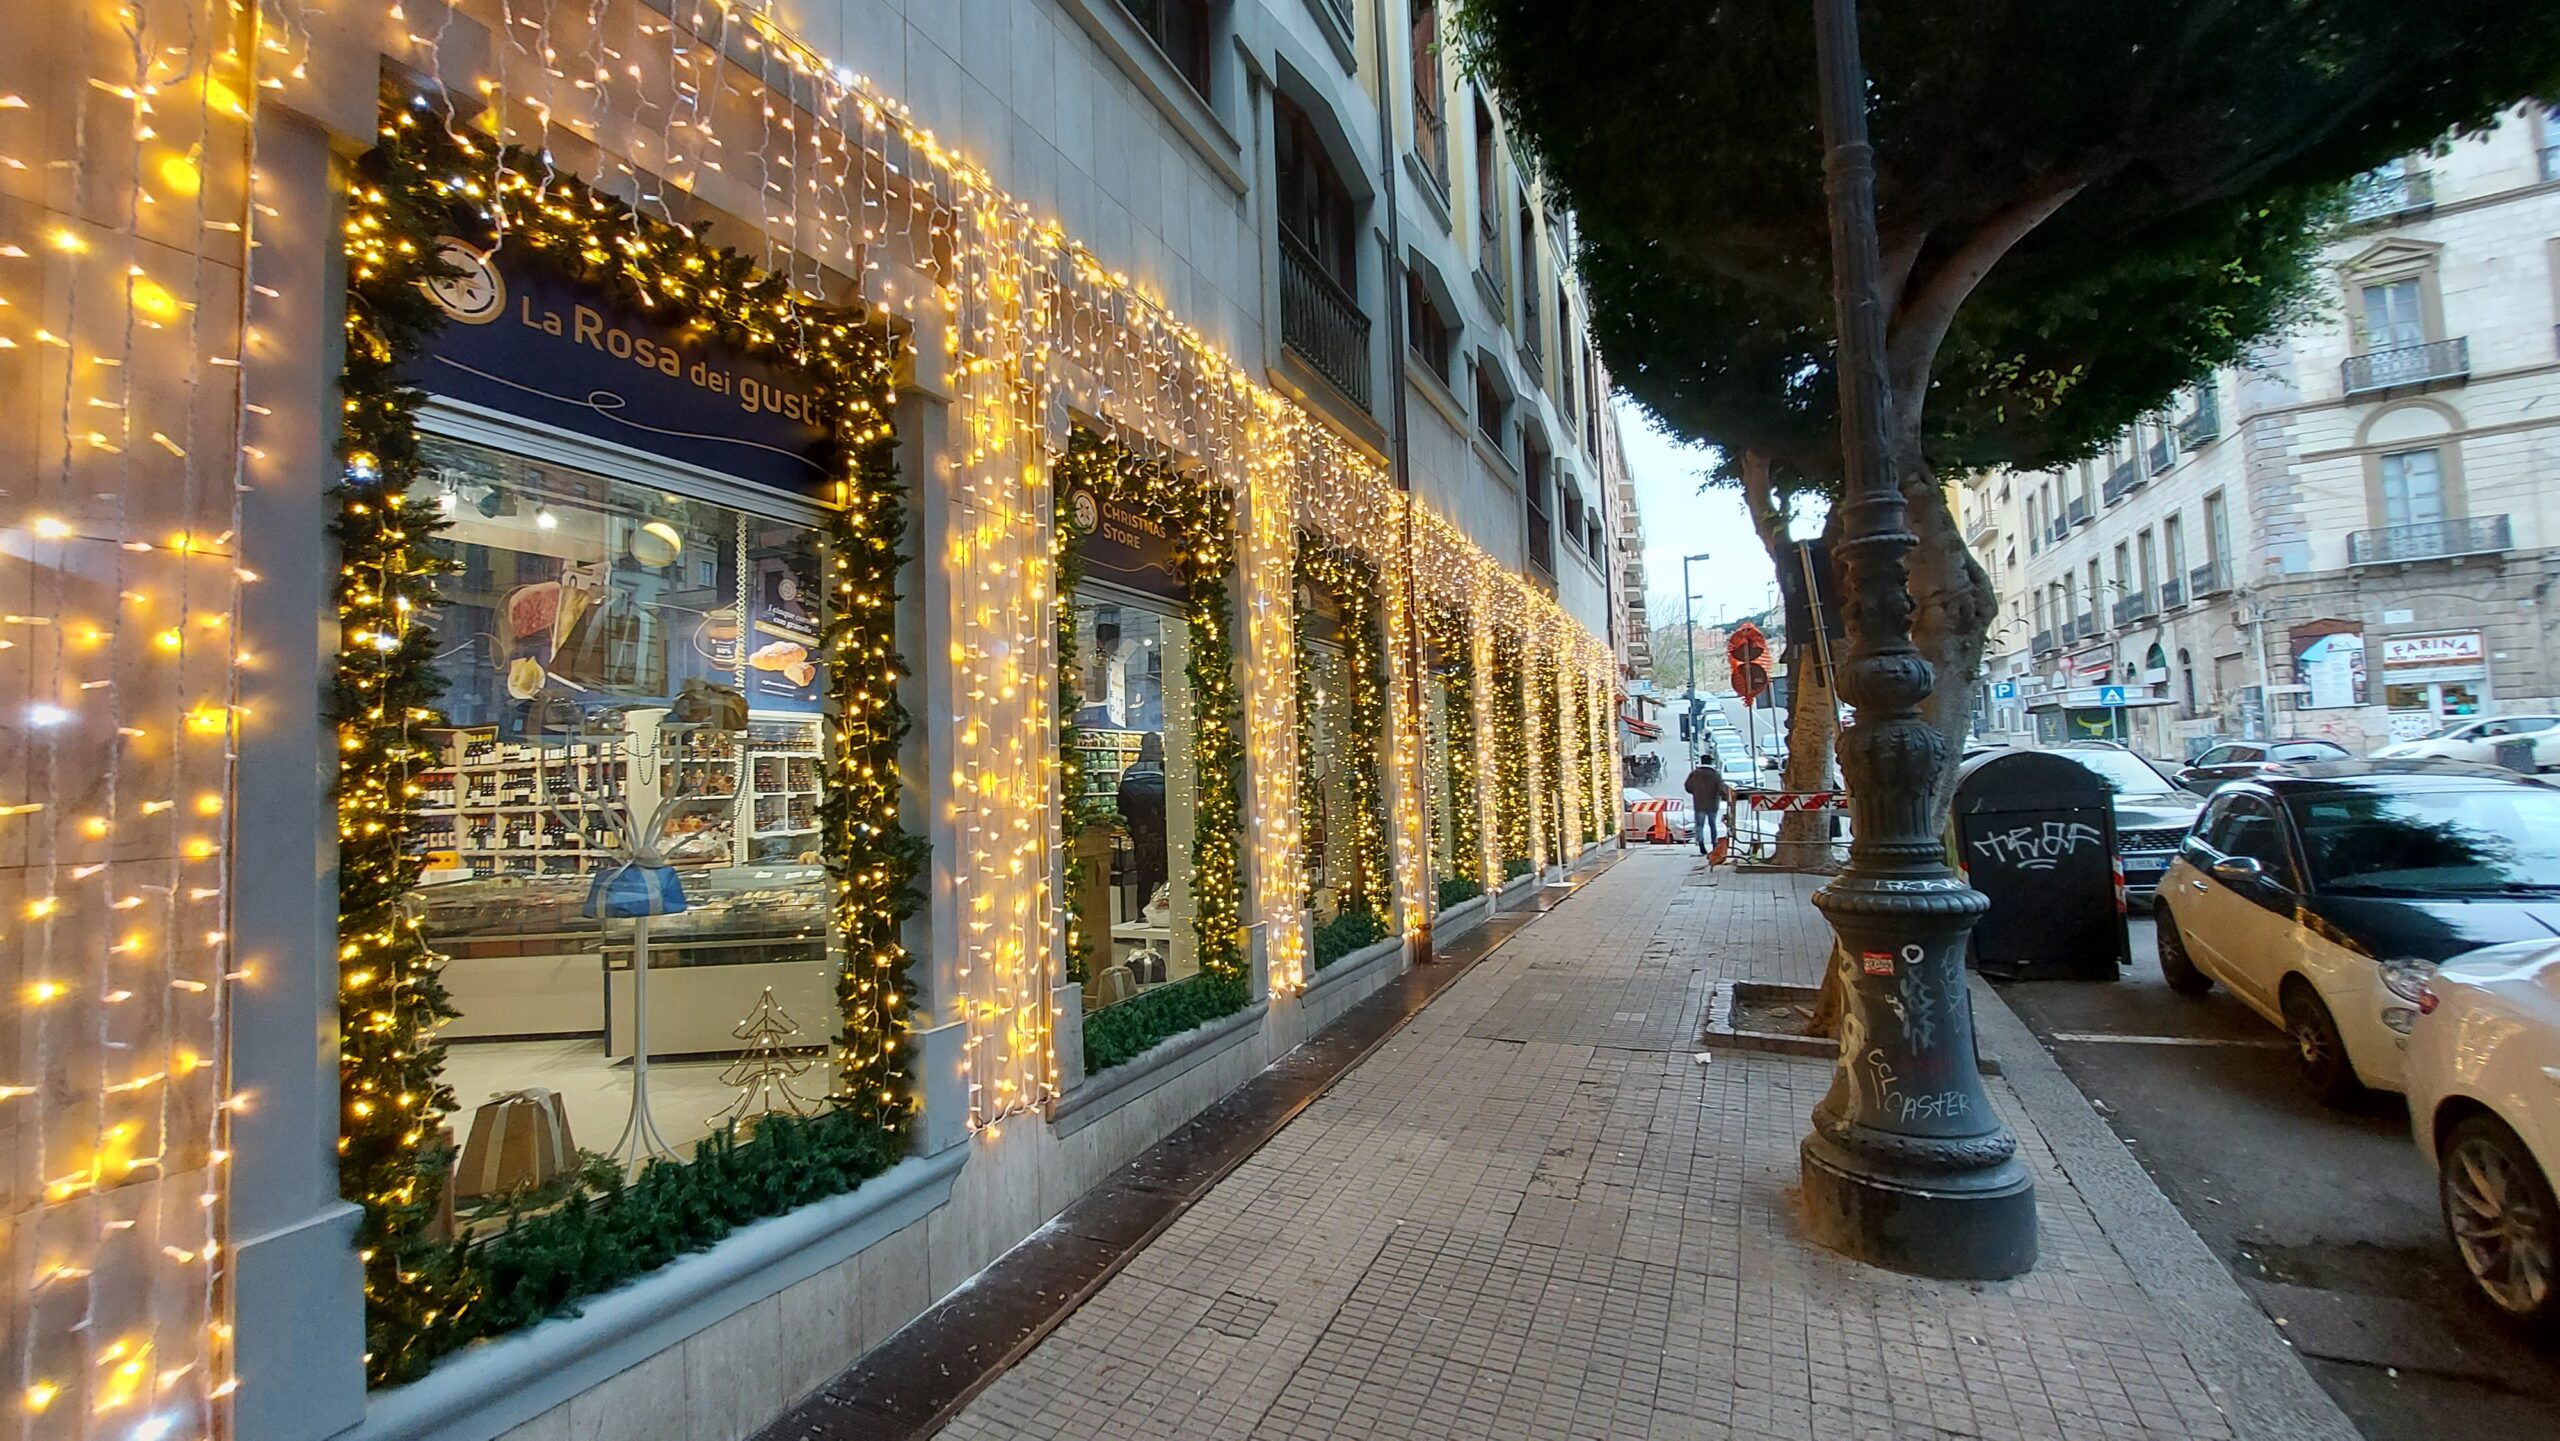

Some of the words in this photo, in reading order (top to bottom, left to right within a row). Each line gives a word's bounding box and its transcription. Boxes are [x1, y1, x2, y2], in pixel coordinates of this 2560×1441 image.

[522, 295, 562, 336] La
[575, 304, 681, 377] Rosa
[690, 361, 730, 395] dei
[739, 377, 821, 428] gusti
[1102, 502, 1167, 539] CHRISTMAS
[1102, 523, 1141, 549] STORE
[2392, 639, 2470, 655] FARINA
[1998, 684, 2011, 697] P
